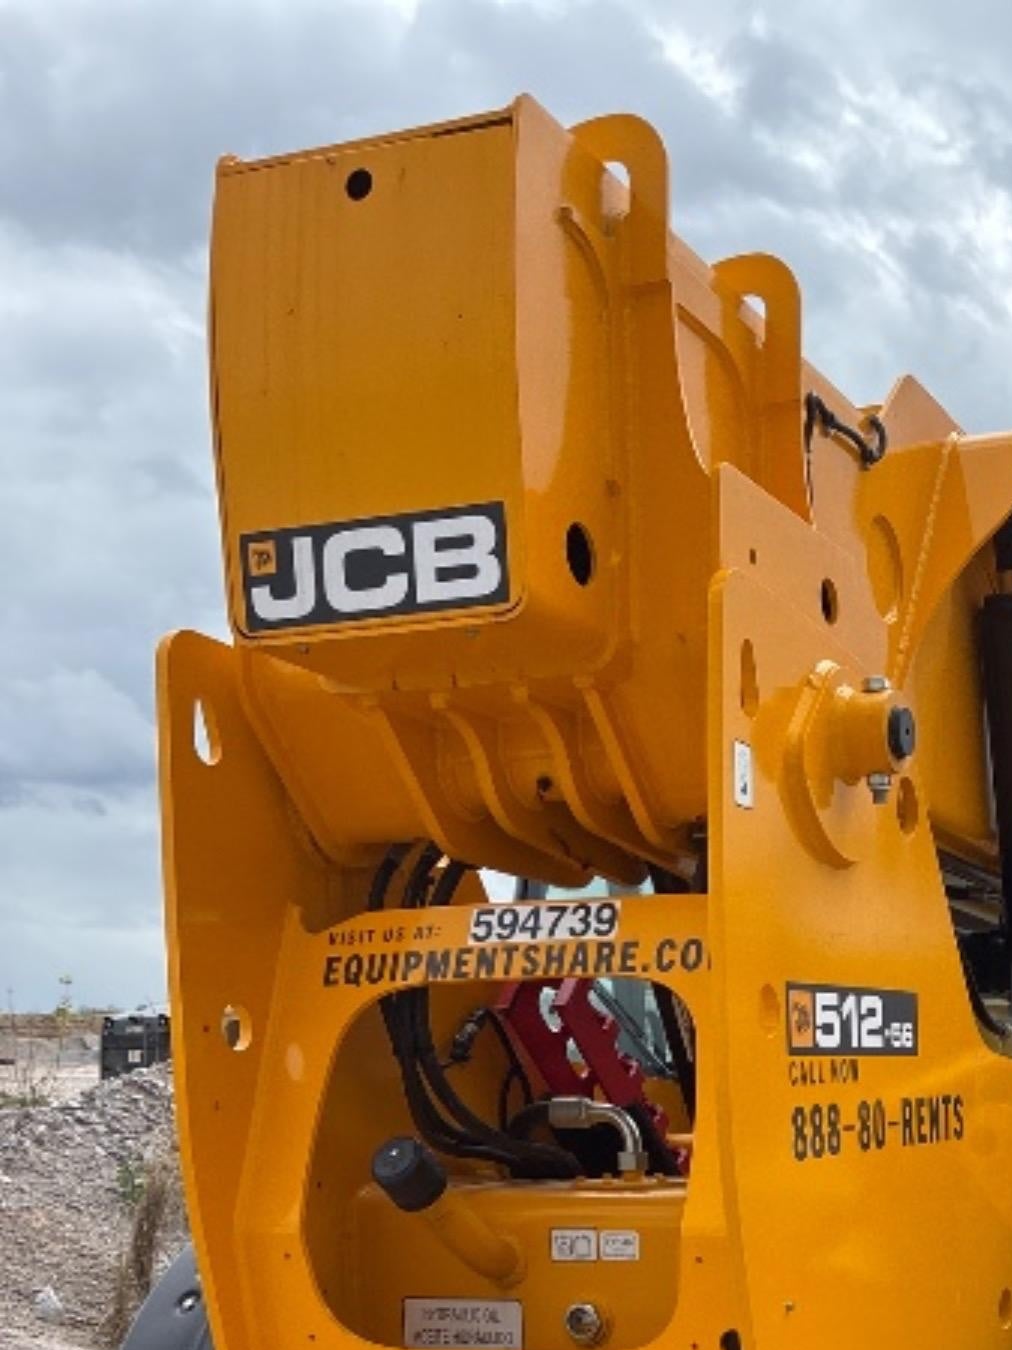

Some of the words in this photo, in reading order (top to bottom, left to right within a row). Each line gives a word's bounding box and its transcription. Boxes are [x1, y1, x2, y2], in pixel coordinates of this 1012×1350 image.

[251, 515, 500, 622] JCB
[327, 928, 375, 946] VISIT
[383, 926, 404, 943] US
[413, 924, 442, 940] AT:
[471, 902, 618, 942] 594739
[322, 937, 712, 987] EQUIPMENTSHARE.CO
[789, 1060, 826, 1087] CALL
[831, 1058, 859, 1083] NOW
[791, 1094, 964, 1162] 888-80-RENTS
